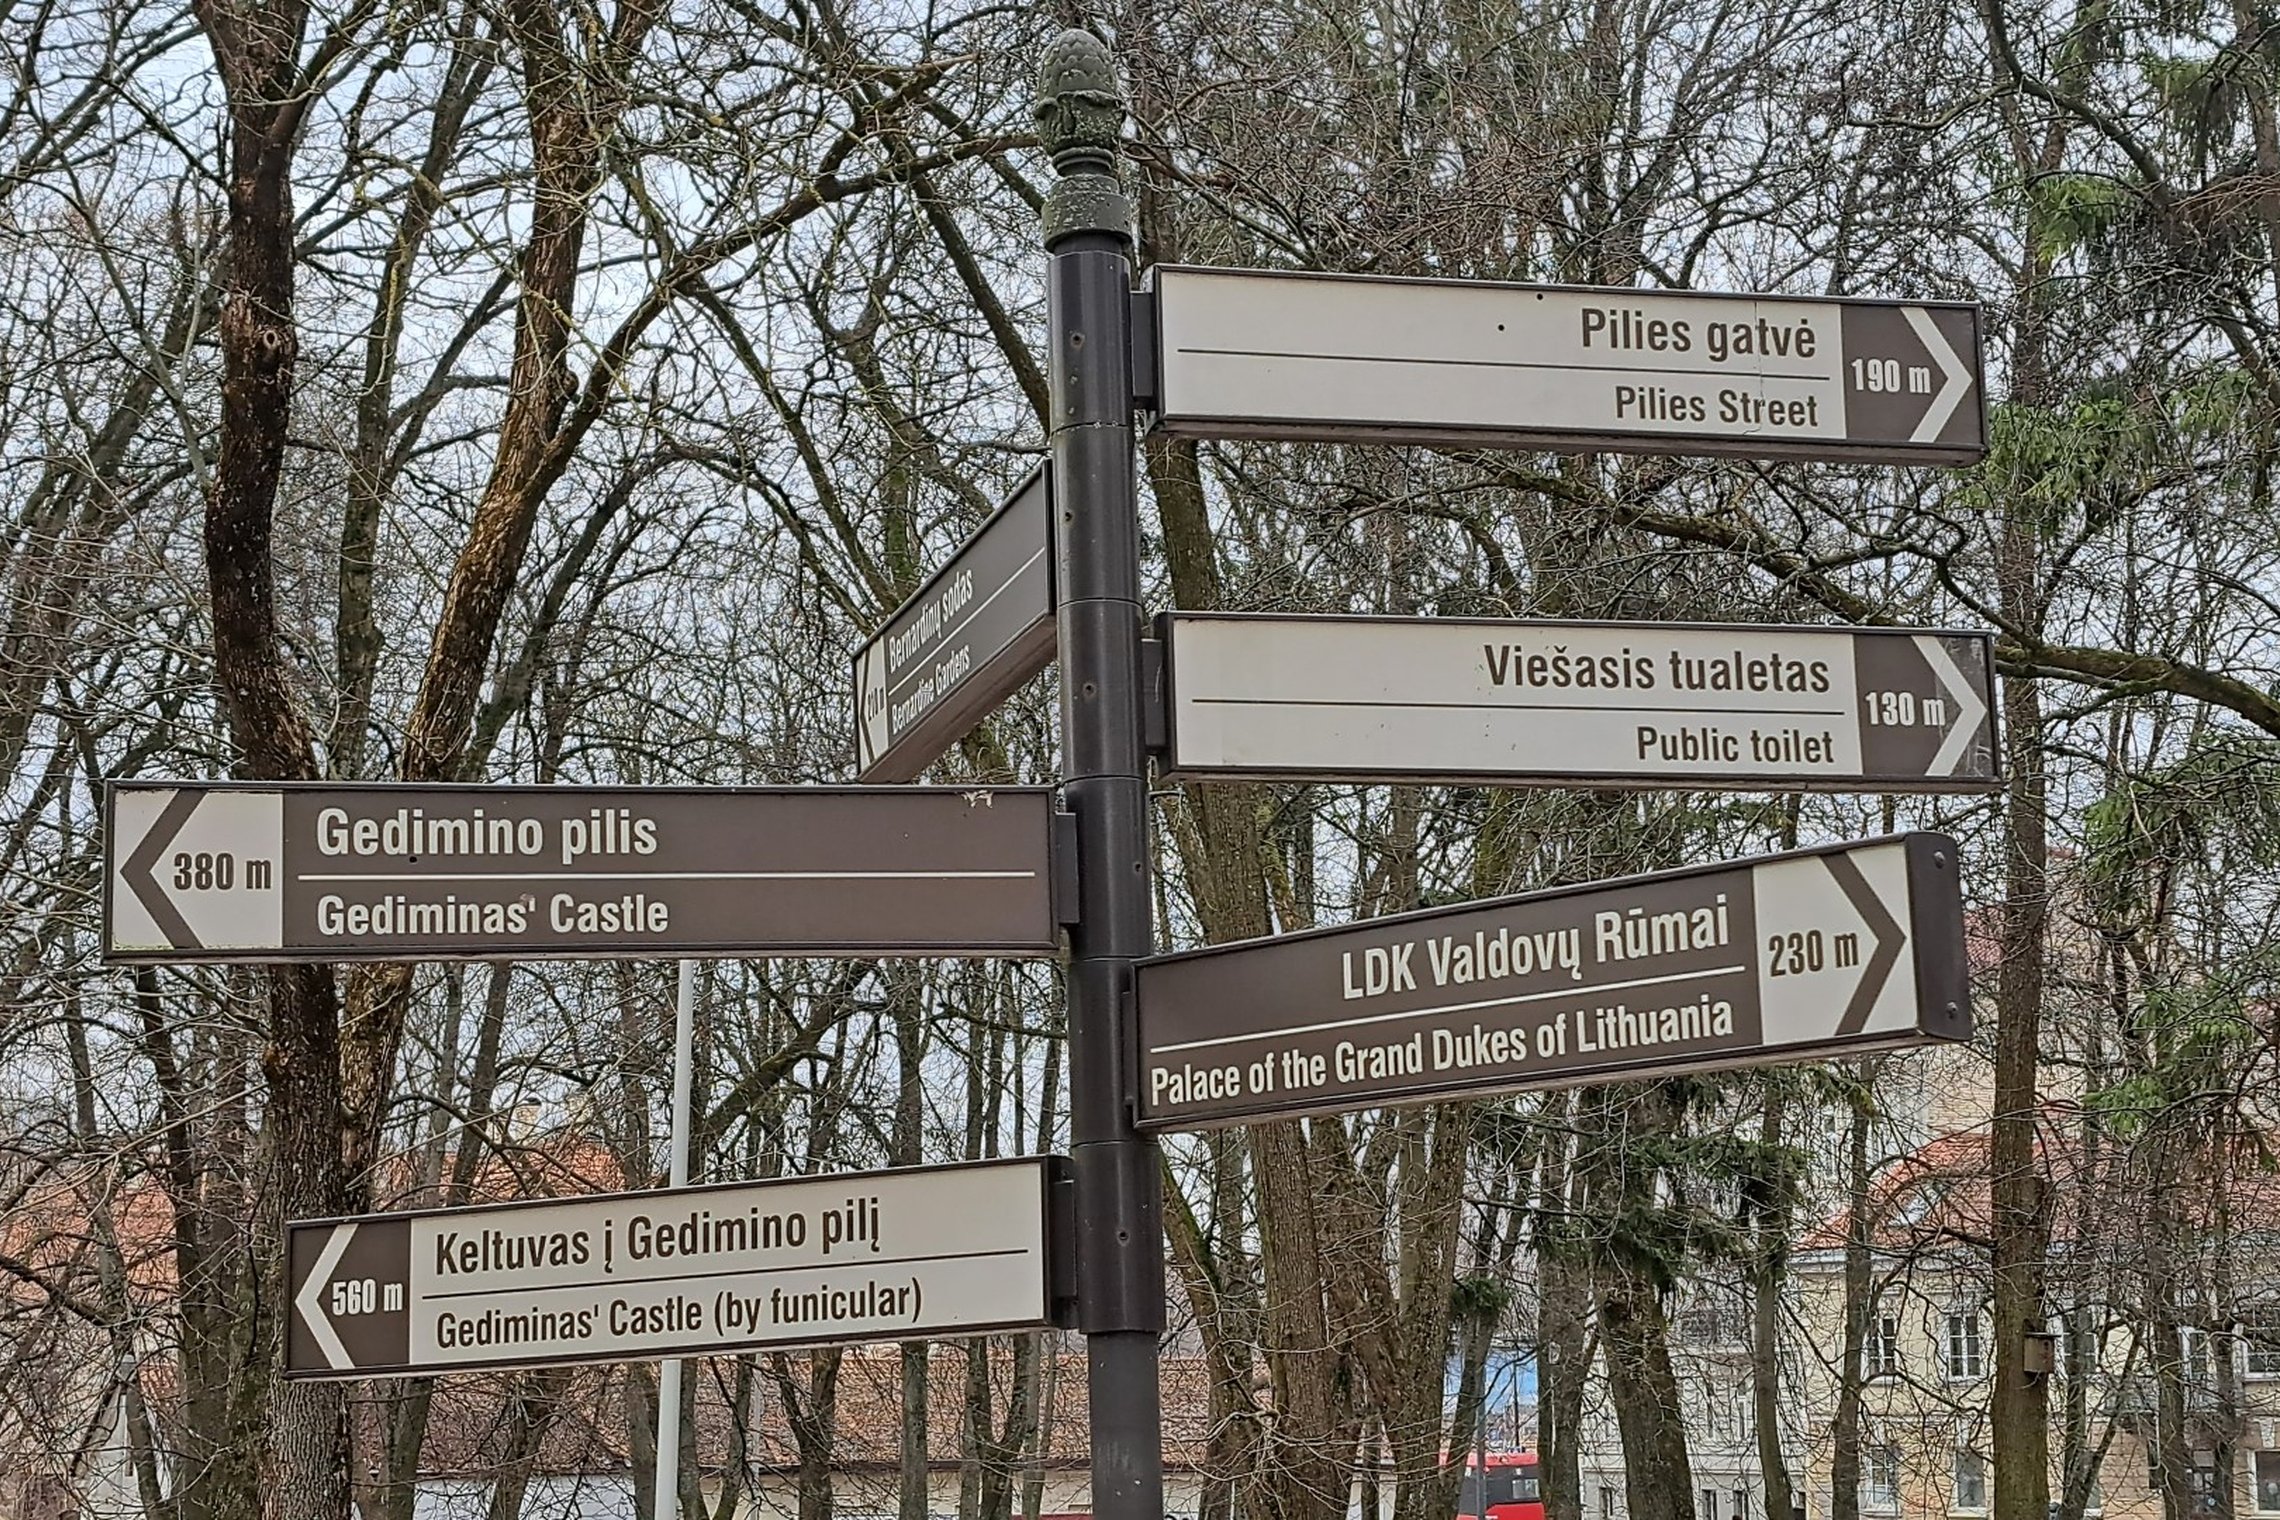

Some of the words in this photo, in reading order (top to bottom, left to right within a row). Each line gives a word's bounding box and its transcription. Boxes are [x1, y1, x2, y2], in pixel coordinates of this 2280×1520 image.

[1581, 308, 1692, 353] Pilies
[1707, 318, 1817, 362] gatvė
[1851, 358, 1901, 394] 190
[1908, 366, 1932, 394] m
[1615, 386, 1706, 422] Pilies
[1718, 389, 1818, 427] Street
[942, 569, 973, 623] sodas
[935, 644, 971, 696] Gardens
[1484, 644, 1656, 689] Viešasis
[1669, 650, 1831, 693] tualetas
[1864, 691, 1915, 727] 130
[1923, 698, 1947, 726] m
[1637, 725, 1740, 762] Public
[1751, 729, 1835, 763] toilet
[316, 807, 544, 856] Gedimino
[562, 808, 658, 865] pilis
[173, 852, 235, 891] 380
[245, 859, 273, 891] m
[317, 895, 537, 935] Gediminas'
[550, 893, 669, 934] Castle
[1342, 942, 1417, 1000] LDK
[1427, 927, 1582, 987] Valdovų
[1595, 894, 1730, 964] Rūmai
[1768, 929, 1824, 978] 230
[1833, 931, 1860, 969] m
[1150, 1063, 1241, 1106] Palace
[1249, 1052, 1275, 1095] of
[1281, 1049, 1327, 1090] the
[1334, 1032, 1422, 1084] Grand
[1433, 1024, 1527, 1071] Dukes
[1536, 1012, 1567, 1058] of
[1576, 994, 1734, 1053] Lithuania
[436, 1229, 590, 1275] Keltuvas
[604, 1219, 614, 1274] į
[627, 1207, 806, 1260] Gedimino
[822, 1196, 881, 1254] pilį
[332, 1279, 376, 1316] 560
[383, 1281, 403, 1312] m
[437, 1304, 600, 1350] Gediminas'
[608, 1295, 702, 1337] Castle
[713, 1290, 762, 1337] (by
[770, 1276, 922, 1324] funicular)
